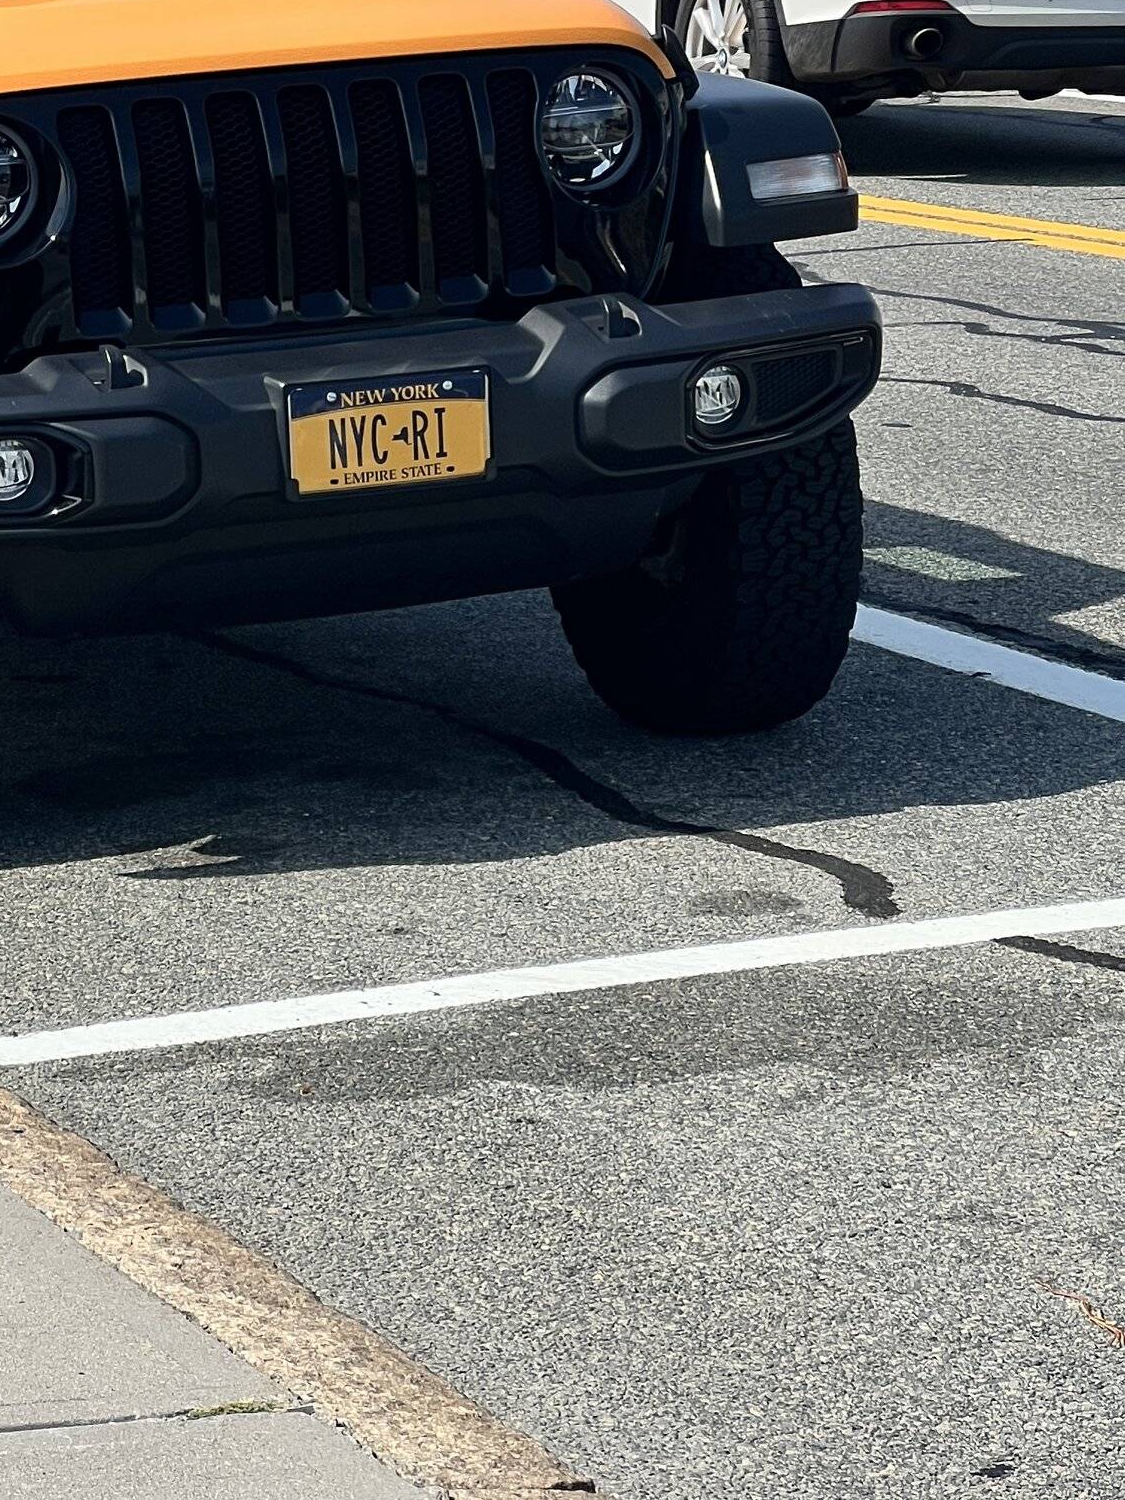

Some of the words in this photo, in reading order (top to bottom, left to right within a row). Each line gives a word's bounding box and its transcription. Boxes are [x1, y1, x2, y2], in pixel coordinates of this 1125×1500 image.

[339, 389, 386, 408] NEW
[391, 383, 440, 401] YORK
[328, 413, 389, 470] NYC
[412, 407, 448, 461] RI
[343, 468, 397, 485] EMPIRE
[401, 462, 443, 479] STATE
